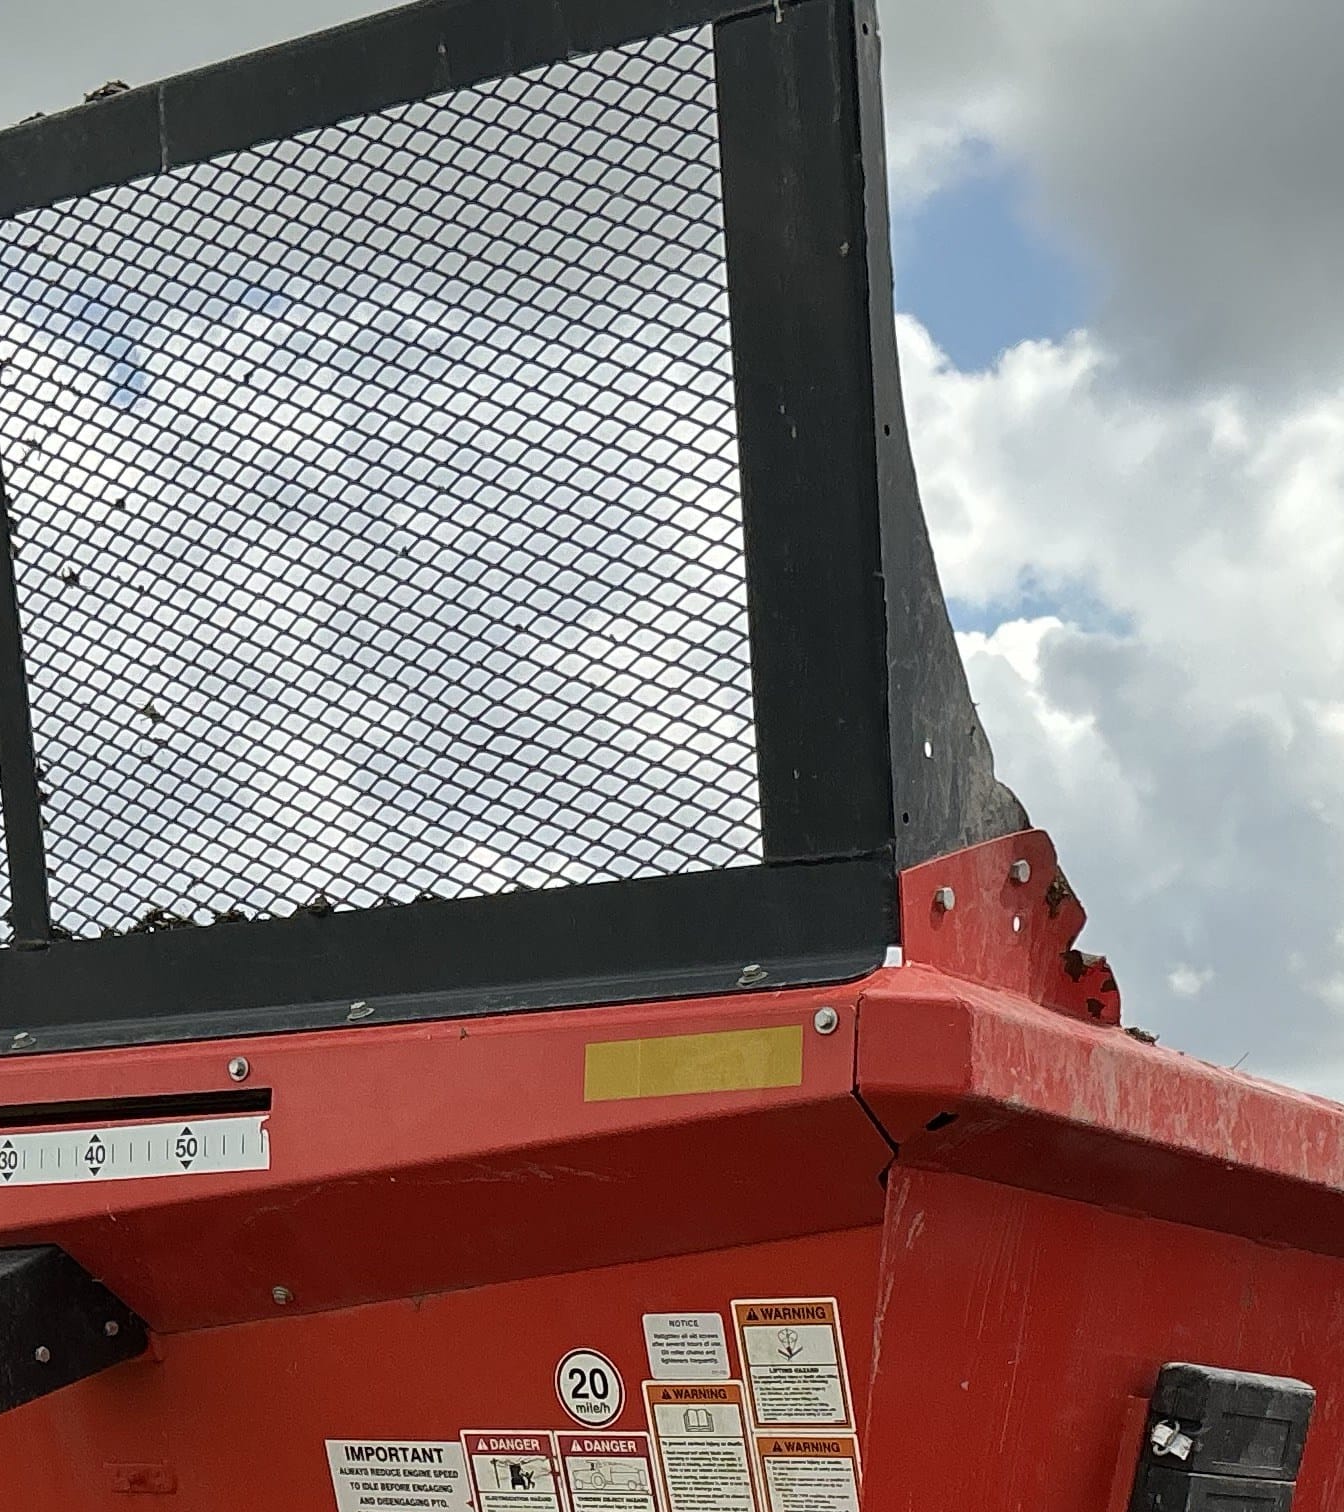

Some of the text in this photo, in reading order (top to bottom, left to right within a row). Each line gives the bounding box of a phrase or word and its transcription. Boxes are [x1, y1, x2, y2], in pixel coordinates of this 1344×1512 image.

[84, 1144, 106, 1165] 40
[174, 1137, 198, 1159] 50
[760, 1306, 826, 1320] WARNING
[668, 1319, 699, 1328] NOTICE
[568, 1368, 609, 1400] 20
[672, 1388, 728, 1400] WARNING
[575, 1401, 611, 1415] mile/h
[489, 1438, 541, 1451] DANGER
[584, 1440, 637, 1453] DANGER
[784, 1441, 841, 1453] WARNING
[344, 1445, 444, 1464] IMPORTANT
[339, 1467, 459, 1479] ALWAYS REDUCE ENGINE SPEED
[350, 1481, 454, 1493] TO IDLE BEFORE ENGAGING
[359, 1496, 450, 1508] AND DISENGAGING PTO.
